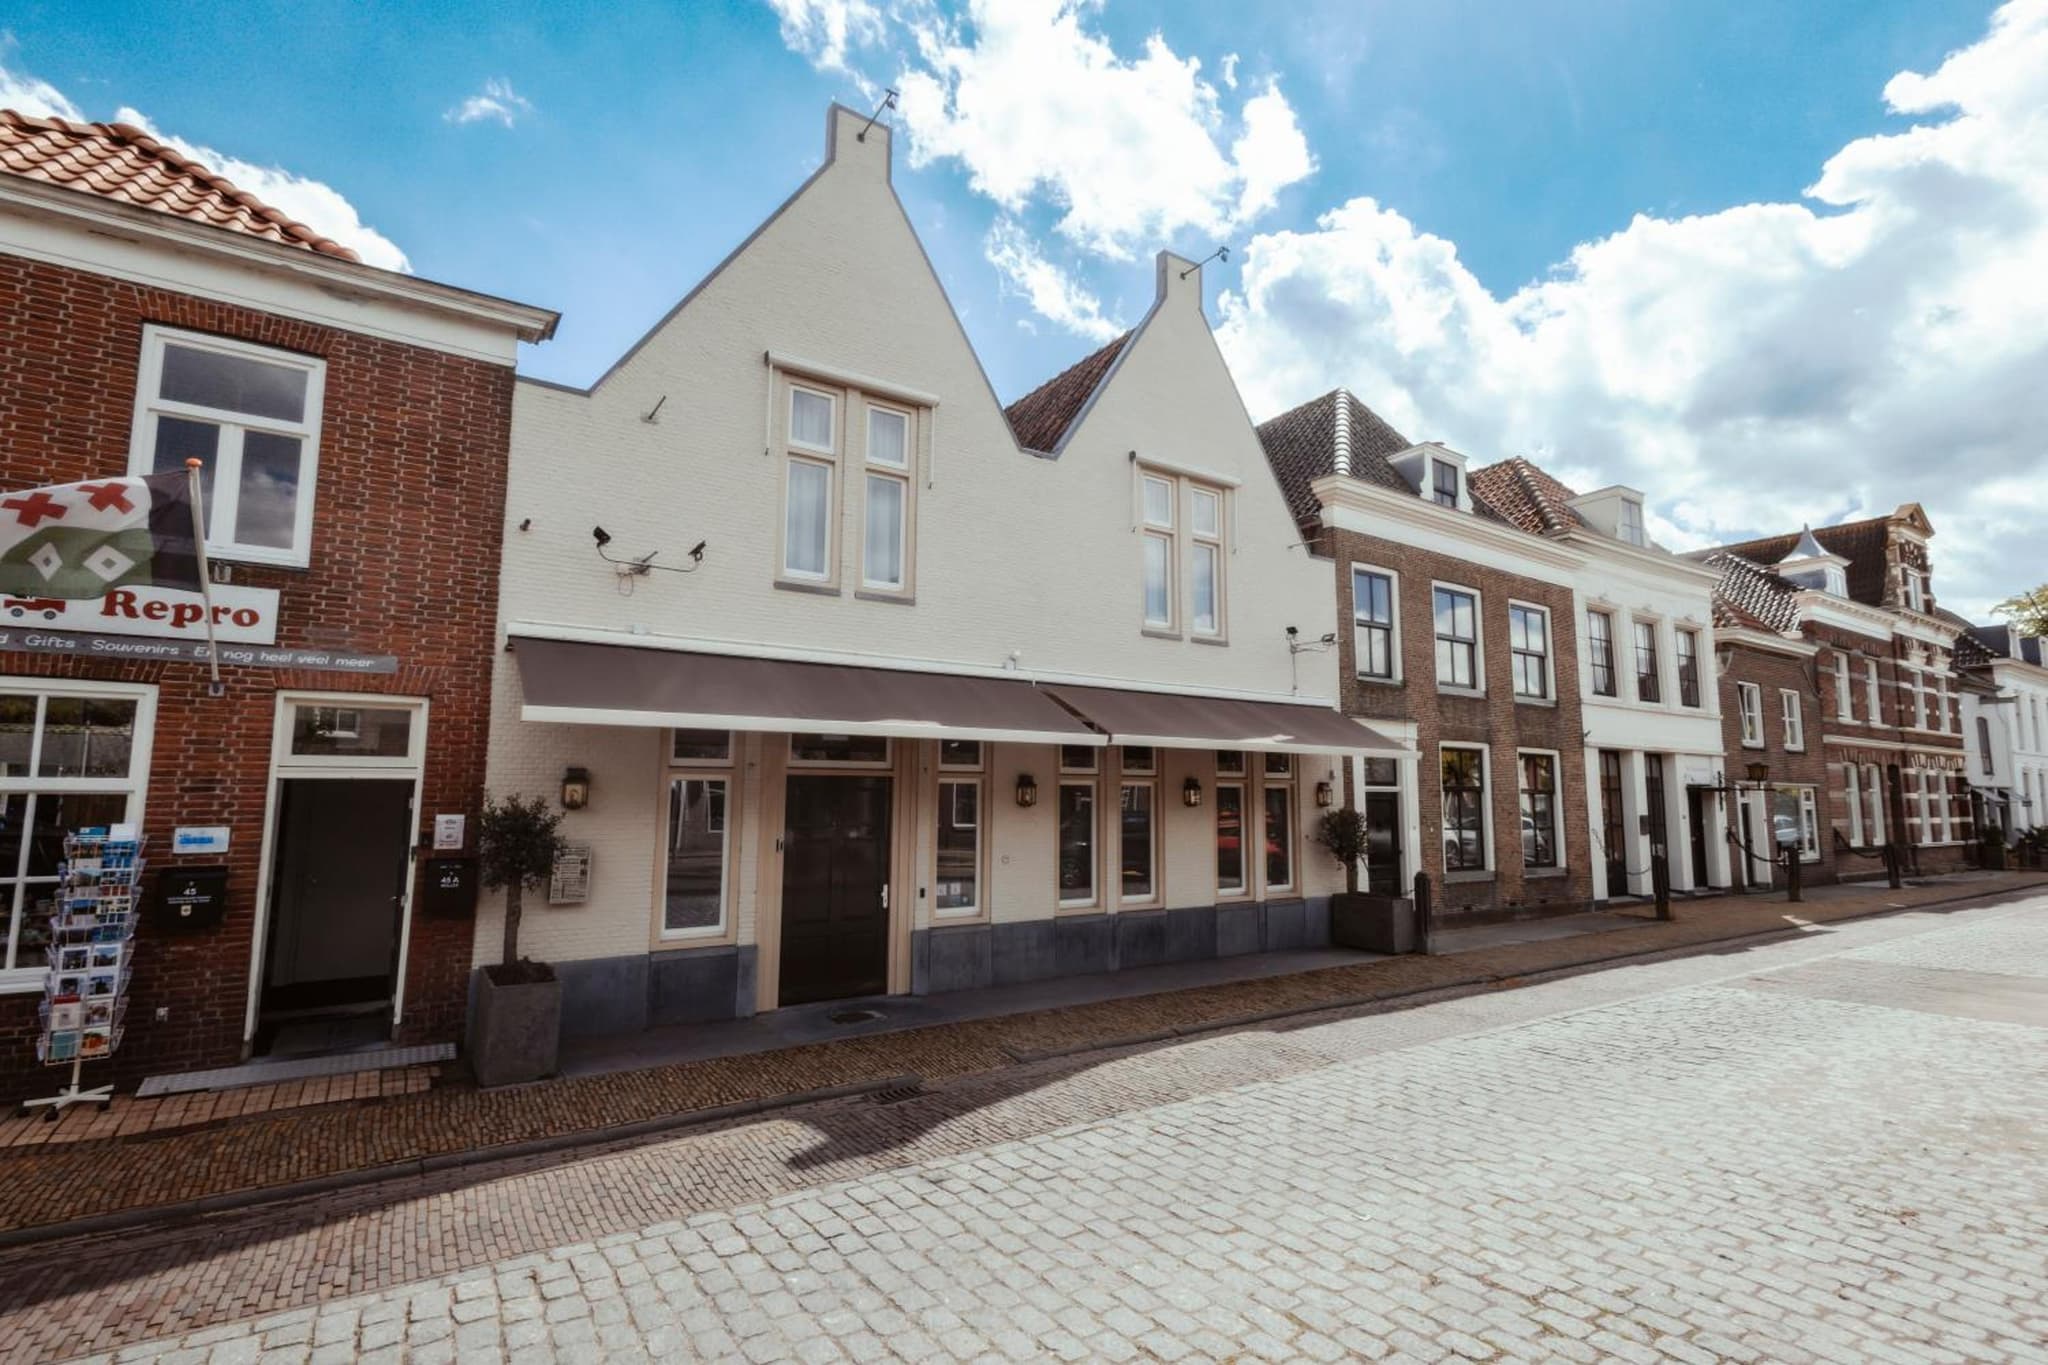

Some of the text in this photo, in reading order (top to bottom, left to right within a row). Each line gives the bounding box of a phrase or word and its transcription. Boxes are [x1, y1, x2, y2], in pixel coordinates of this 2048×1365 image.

[99, 590, 260, 628] Repro
[25, 634, 76, 649] Gifts
[91, 639, 180, 655] Souvenirs
[223, 651, 254, 663] nog
[260, 652, 292, 663] heel
[335, 658, 376, 668] meer
